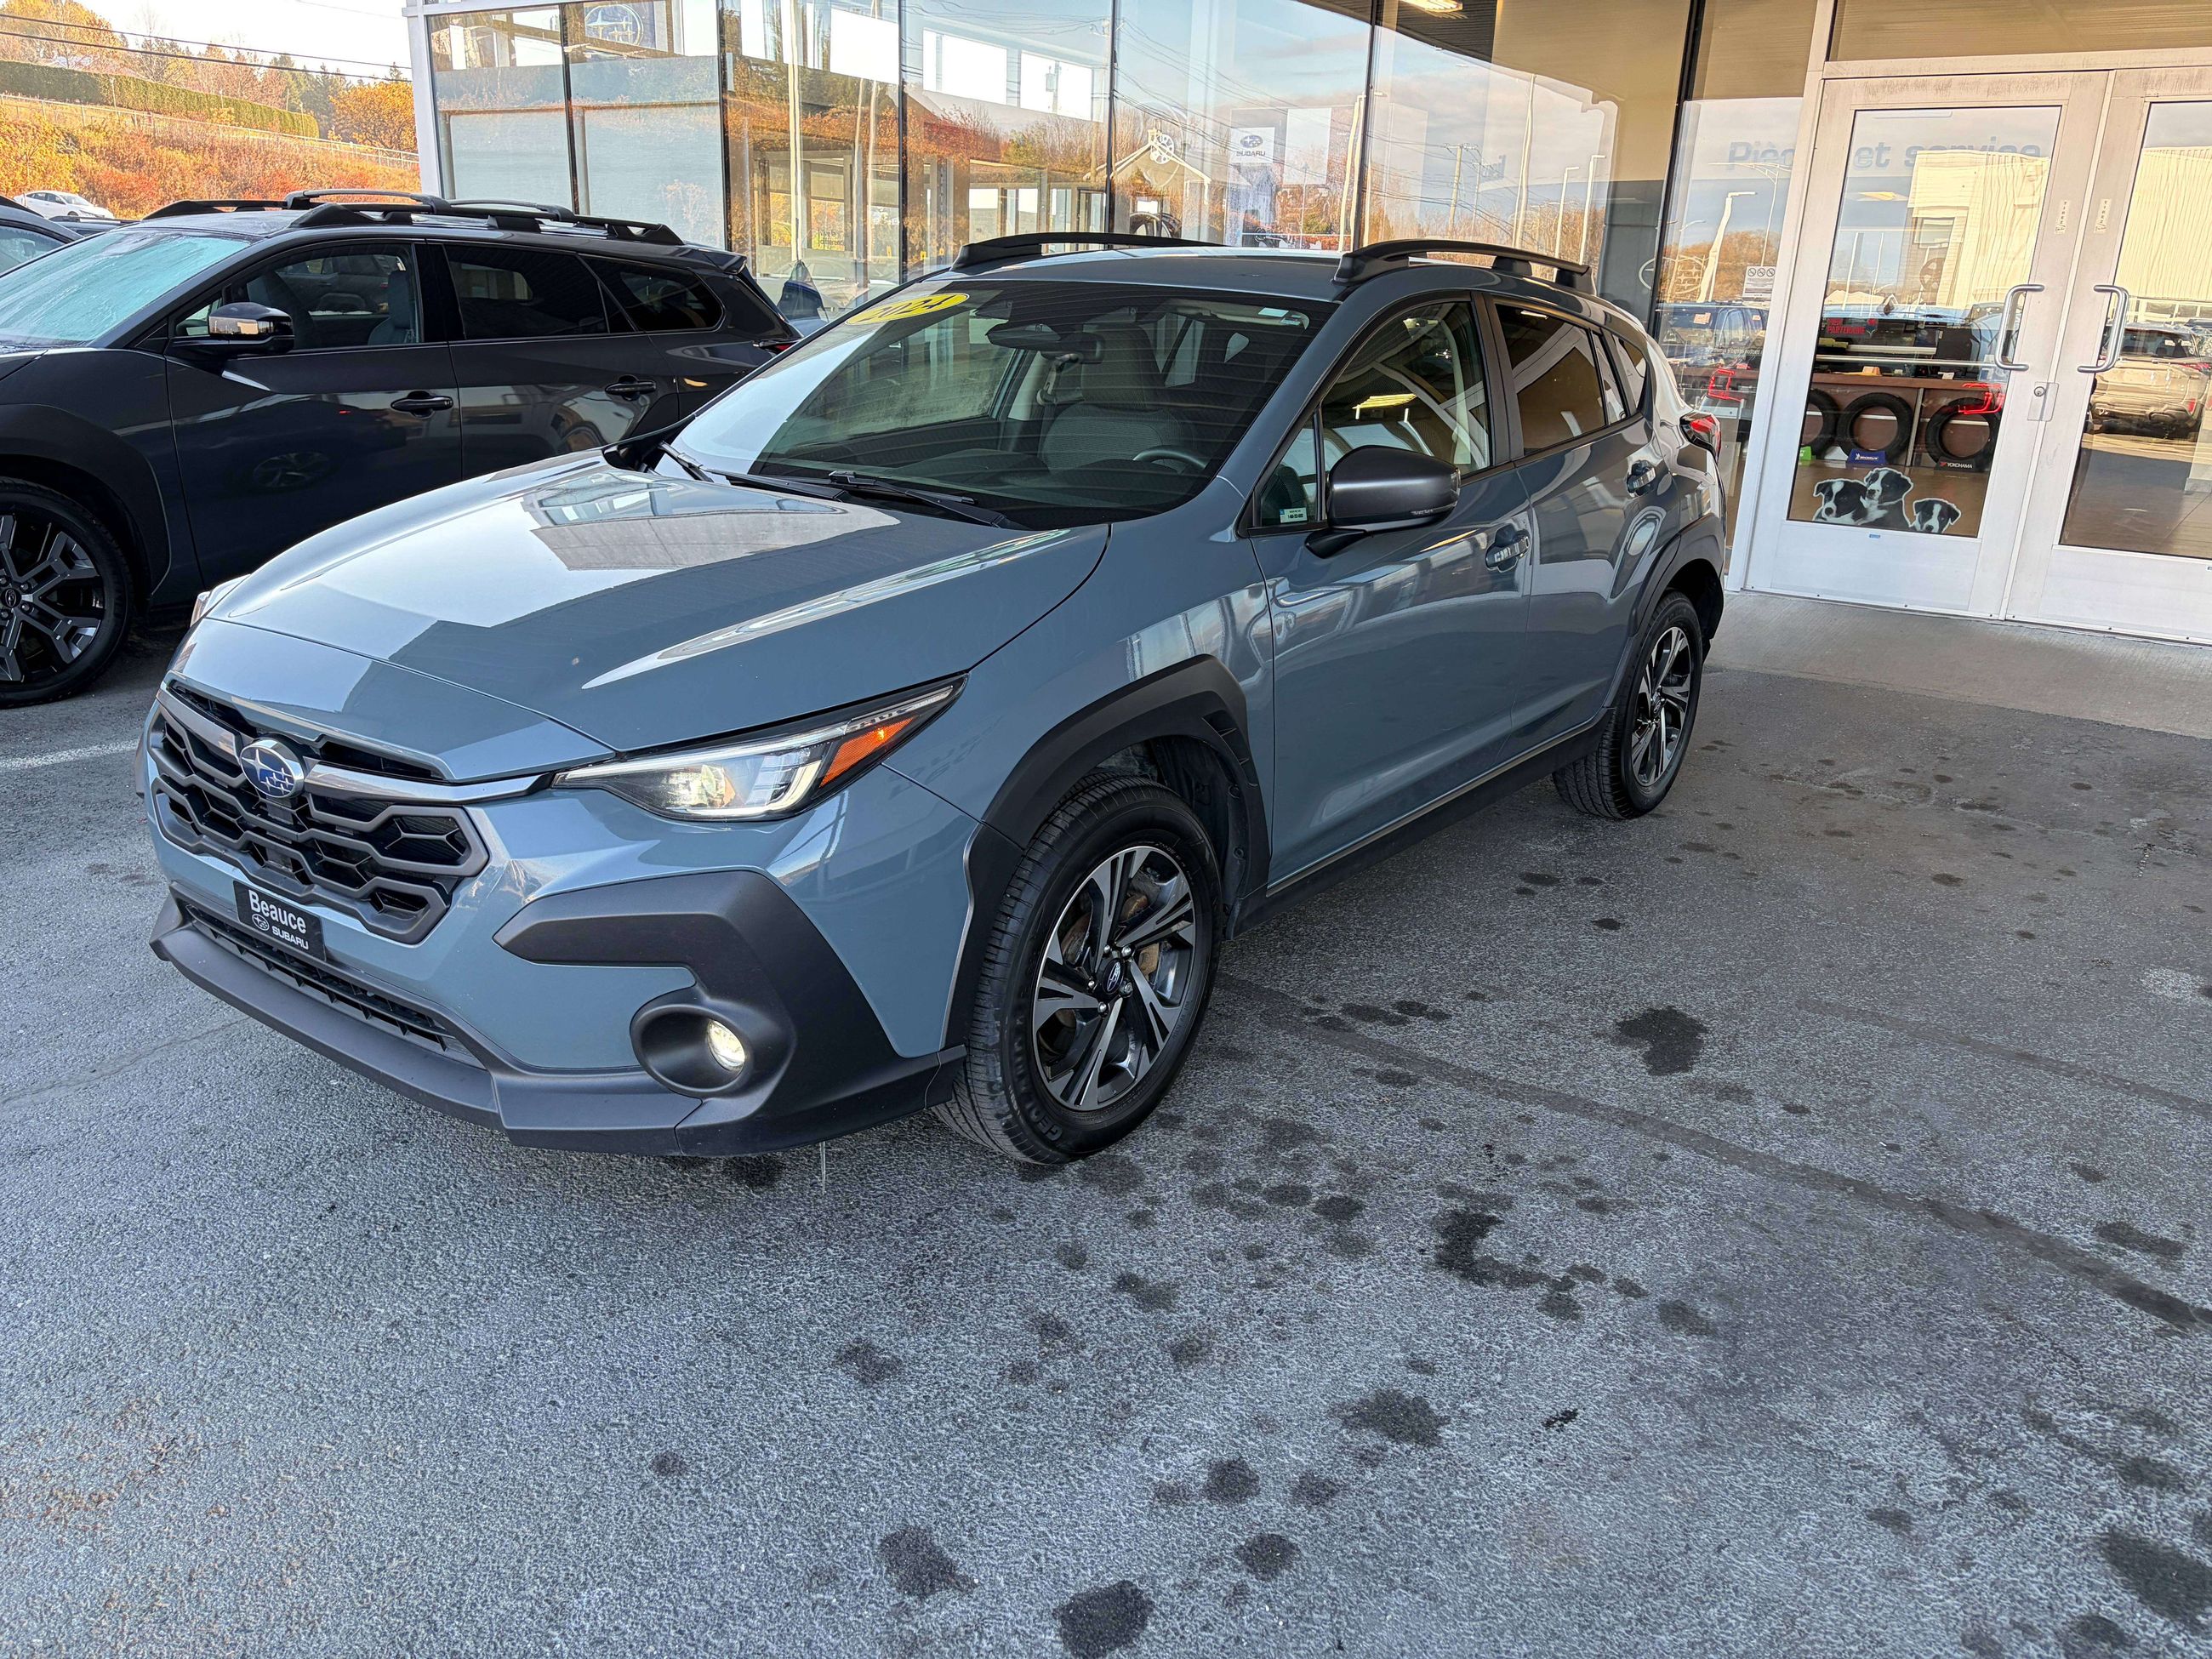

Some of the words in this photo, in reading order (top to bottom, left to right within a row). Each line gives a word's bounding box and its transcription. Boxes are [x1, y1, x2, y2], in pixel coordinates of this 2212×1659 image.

[1728, 140, 1794, 171] Pièc
[1854, 142, 1891, 168] et
[856, 294, 958, 322] 2024
[248, 889, 306, 934] Beauce
[271, 926, 309, 949] SUBARU
